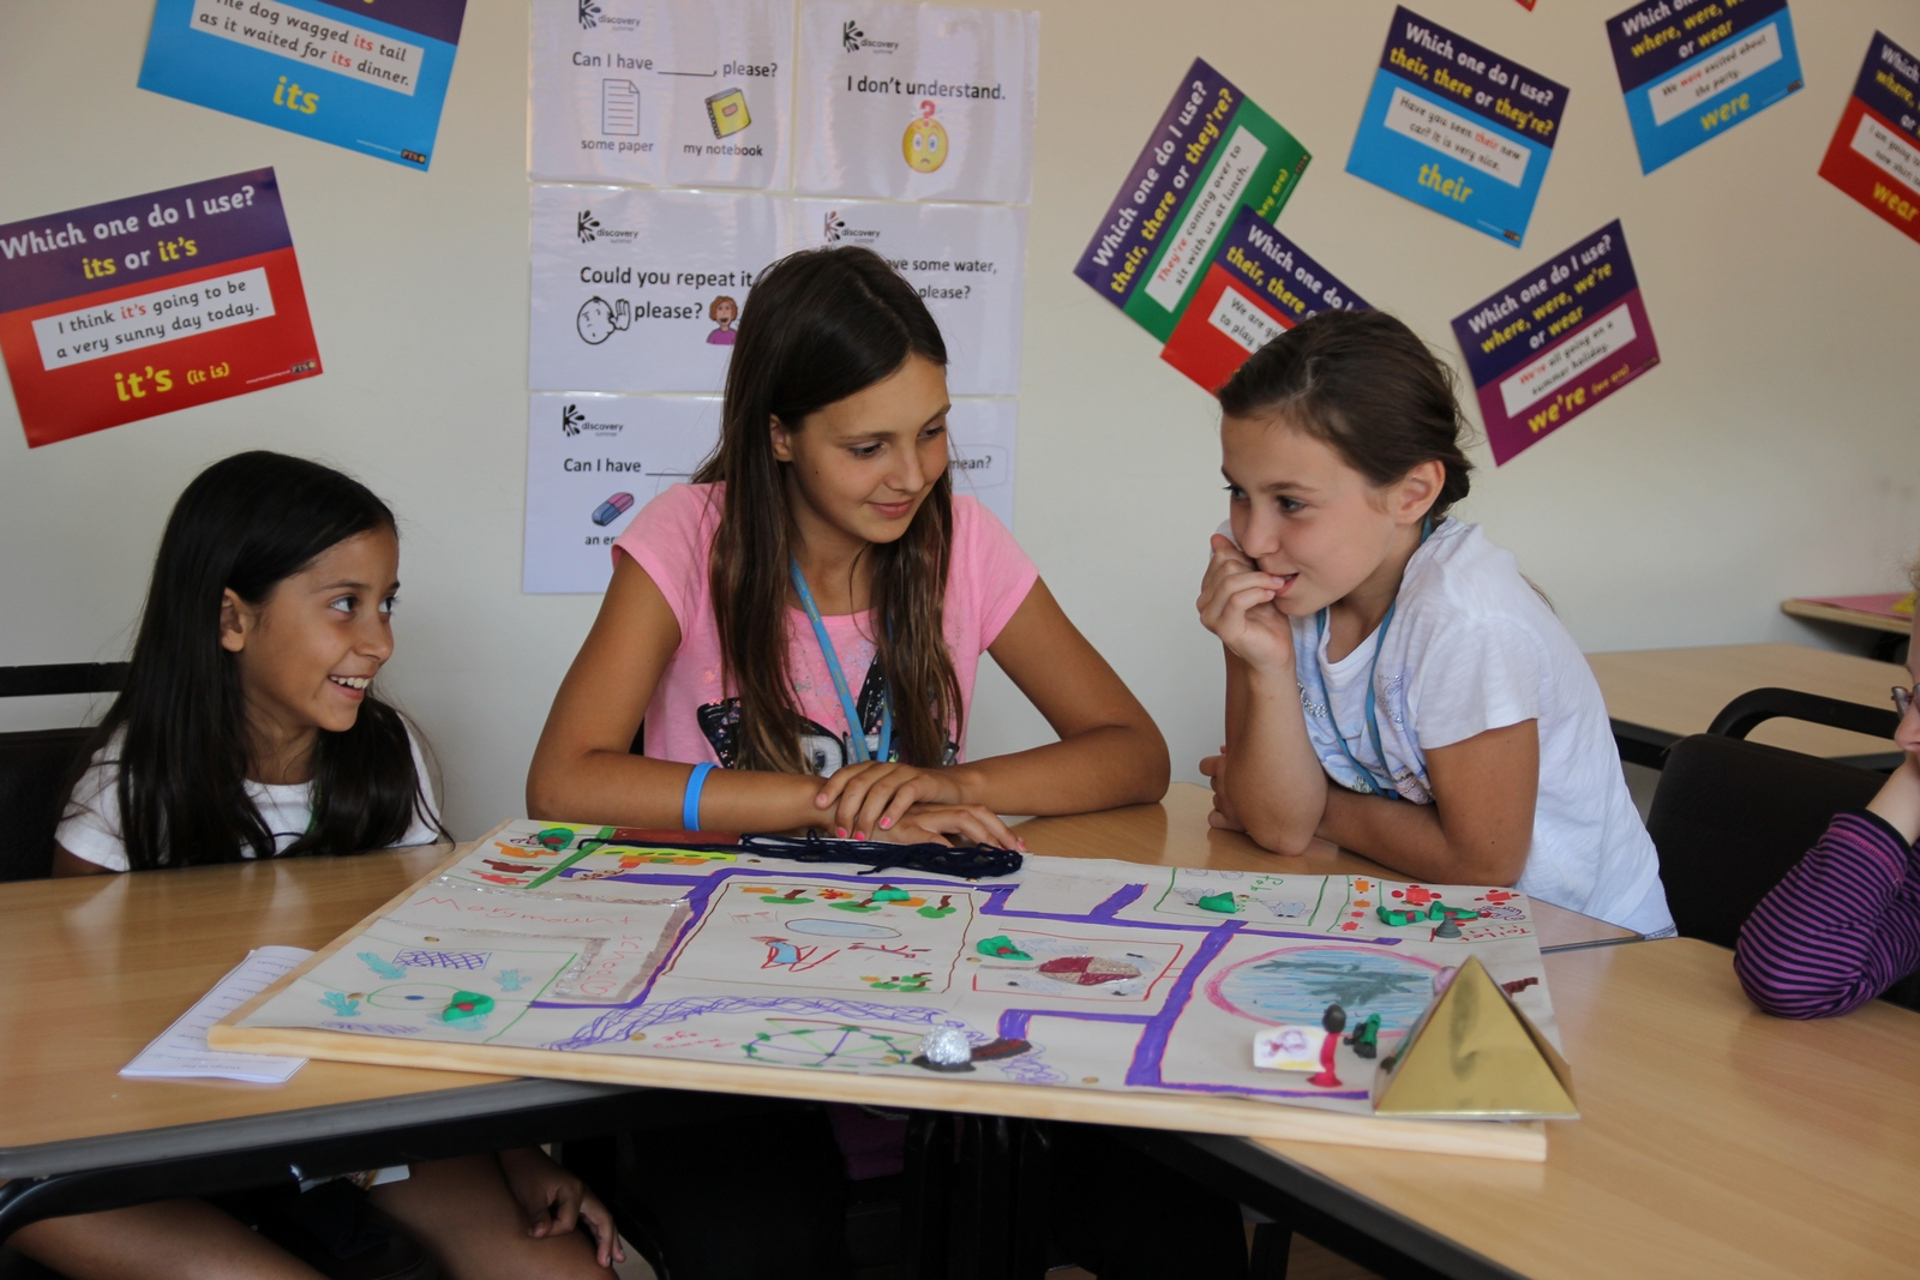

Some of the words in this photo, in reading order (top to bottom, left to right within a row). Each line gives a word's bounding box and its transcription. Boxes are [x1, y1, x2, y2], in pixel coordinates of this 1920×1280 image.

[249, 1, 280, 24] dog
[286, 16, 349, 43] wagged
[353, 34, 373, 51] its
[379, 43, 406, 62] tail
[598, 15, 641, 27] discovery
[1622, 1, 1672, 37] Which
[1631, 26, 1682, 58] where,
[1683, 3, 1723, 30] were,
[1678, 40, 1695, 59] or
[1697, 19, 1733, 48] wear
[199, 13, 218, 26] as
[224, 17, 237, 32] it
[243, 25, 299, 51] waited
[300, 42, 327, 59] for
[331, 51, 352, 68] its
[357, 60, 409, 86] dinner.
[860, 38, 899, 49] discovery
[1880, 43, 1919, 83] Which
[572, 51, 601, 67] Can
[606, 53, 611, 68] I
[617, 54, 653, 70] have
[723, 61, 778, 78] please?
[1405, 22, 1454, 60] Which
[1457, 52, 1485, 75] one
[1488, 64, 1509, 86] do
[1510, 74, 1519, 90] I
[1520, 80, 1554, 106] use?
[273, 76, 320, 114] its
[847, 75, 852, 91] I
[906, 80, 1006, 100] understand.
[1389, 47, 1430, 80] their,
[1433, 68, 1473, 99] there
[1475, 91, 1494, 107] or
[1494, 97, 1554, 136] they're?
[1400, 95, 1426, 117] Have
[1428, 110, 1447, 126] you
[1450, 121, 1473, 138] seen
[1474, 131, 1499, 150] their
[1700, 93, 1750, 131] were
[1900, 114, 1917, 131] or
[581, 138, 615, 150] some
[618, 140, 653, 153] paper
[684, 144, 702, 156] my
[706, 144, 763, 157] notebook
[1092, 206, 1138, 267] Which
[1133, 168, 1160, 204] one
[1154, 140, 1176, 166] do
[1168, 124, 1183, 139] I
[1178, 80, 1207, 126] use?
[1110, 246, 1149, 294] their,
[1141, 191, 1176, 241] there
[1173, 165, 1190, 189] or
[1185, 88, 1233, 164] they're?
[1417, 162, 1474, 203] their
[1157, 239, 1188, 282] They're
[1186, 191, 1216, 236] coming
[1213, 162, 1232, 189] over
[1230, 145, 1242, 159] to
[1872, 182, 1919, 221] wear
[0, 222, 87, 259] Which
[93, 216, 140, 240] one
[147, 203, 179, 228] do
[186, 198, 196, 219] I
[202, 185, 255, 216] use?
[597, 228, 638, 240] discovery
[844, 228, 881, 239] discovery
[1175, 269, 1188, 285] sit
[1188, 237, 1206, 265] with
[1205, 221, 1216, 235] us
[1215, 203, 1226, 218] at
[1223, 165, 1249, 201] lunch.
[82, 257, 117, 280] its
[124, 250, 151, 270] or
[158, 237, 198, 262] it's
[580, 266, 632, 284] Could
[637, 271, 670, 288] you
[676, 271, 735, 289] repeat
[740, 270, 753, 287] it
[912, 259, 950, 271] some
[954, 260, 998, 275] water,
[1248, 224, 1294, 273] Which
[1295, 267, 1322, 294] one
[1323, 287, 1343, 309] do
[918, 285, 971, 300] please?
[1226, 246, 1264, 286] their,
[1267, 277, 1306, 314] there
[1468, 294, 1520, 334] Which
[1520, 278, 1548, 303] one
[1549, 265, 1570, 285] do
[1570, 255, 1579, 271] I
[1581, 234, 1612, 265] use?
[58, 322, 64, 334] I
[69, 310, 116, 332] think
[120, 303, 147, 320] it's
[152, 292, 199, 316] going
[204, 287, 222, 300] to
[228, 280, 246, 295] be
[634, 301, 704, 322] please?
[1231, 297, 1247, 315] We
[1248, 314, 1264, 328] are
[1481, 318, 1532, 354] where,
[1532, 291, 1573, 321] were,
[1574, 262, 1613, 295] we're
[56, 347, 67, 359] a
[72, 336, 109, 355] very
[115, 325, 166, 346] sunny
[171, 315, 202, 333] day
[207, 304, 260, 323] today.
[1220, 313, 1231, 326] to
[1230, 324, 1255, 347] play
[1528, 330, 1546, 350] or
[1548, 305, 1584, 337] wear
[1548, 352, 1563, 367] all
[1563, 335, 1591, 360] going
[1592, 327, 1605, 340] on
[114, 366, 173, 402] it's
[186, 369, 206, 385] (it
[210, 362, 230, 379] is)
[581, 422, 624, 432] discovery
[1527, 386, 1587, 434] we're
[564, 458, 592, 472] Can
[597, 459, 601, 472] I
[605, 457, 642, 472] have
[585, 536, 600, 546] an
